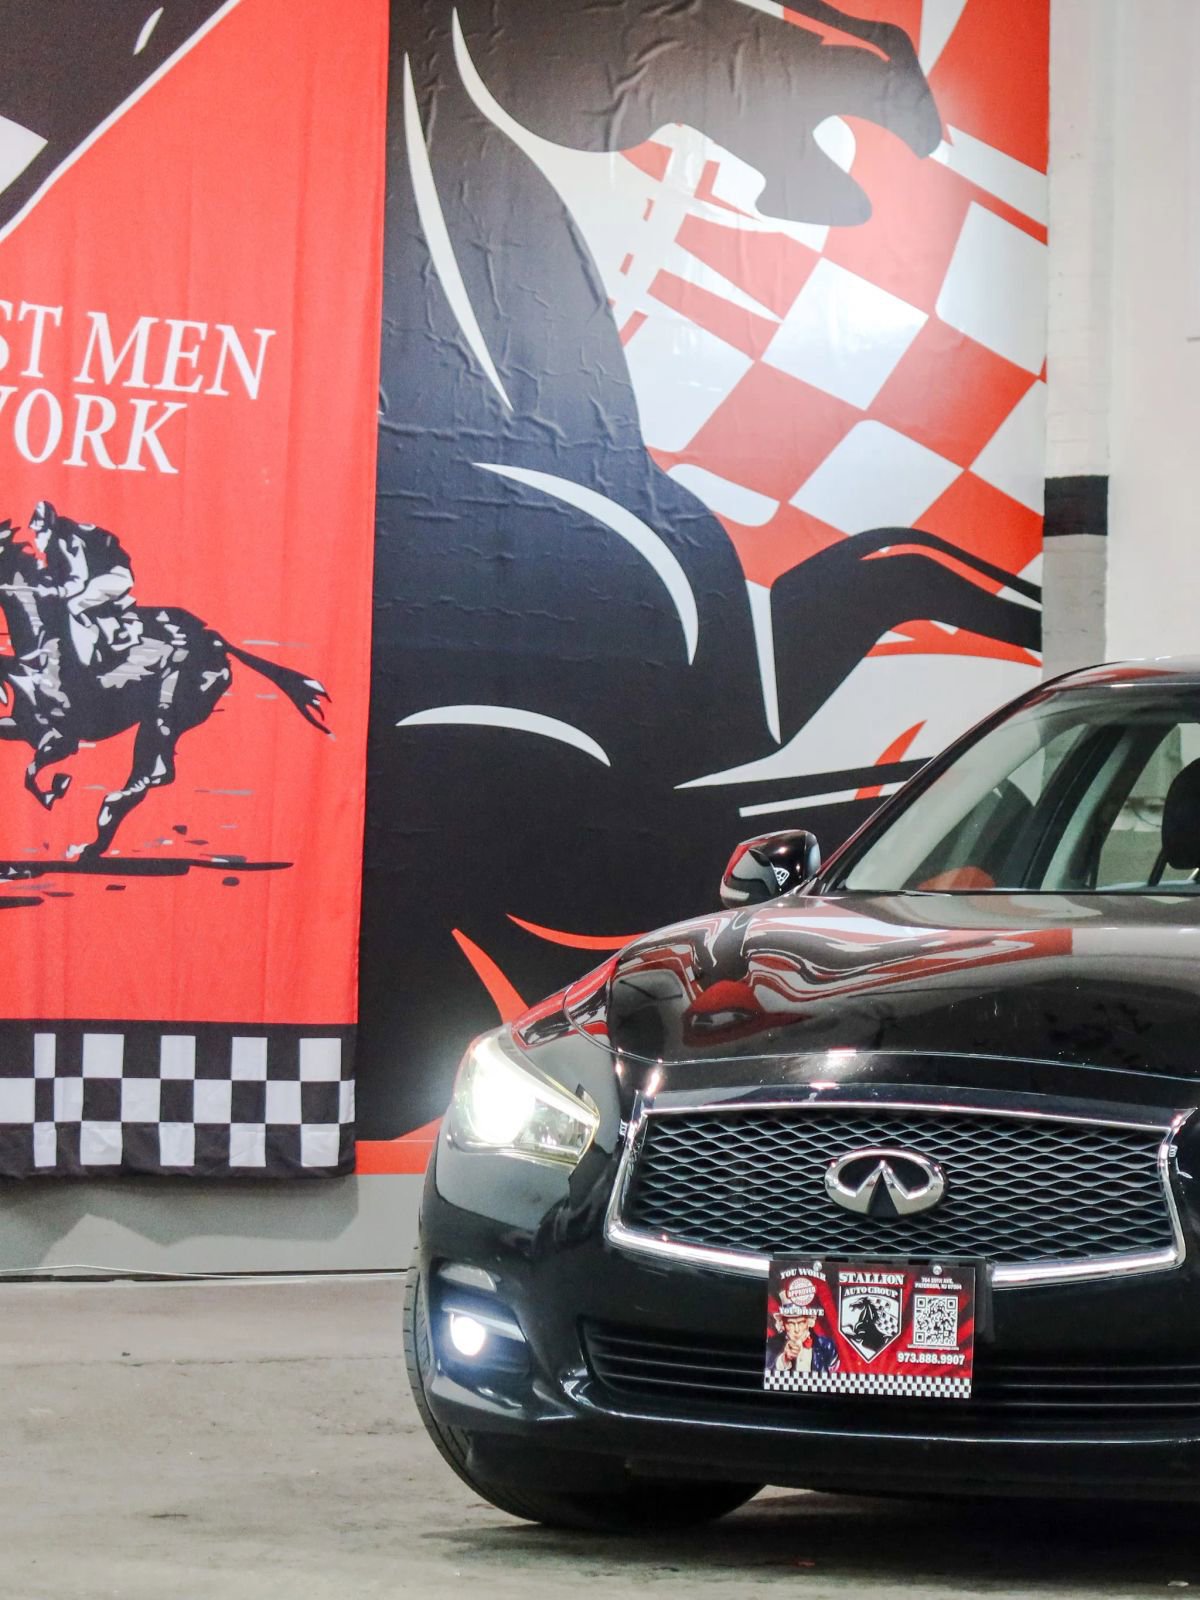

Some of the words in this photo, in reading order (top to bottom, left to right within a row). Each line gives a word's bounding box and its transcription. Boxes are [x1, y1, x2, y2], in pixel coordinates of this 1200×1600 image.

[0, 300, 63, 378] T
[73, 311, 276, 400] MEN
[0, 385, 187, 474] ORK
[780, 1268, 797, 1279] YOU
[798, 1267, 826, 1281] WORK
[839, 1271, 904, 1284] STALLION
[844, 1287, 867, 1296] AUTO
[867, 1287, 898, 1298] GROUP
[797, 1308, 824, 1316] DRIVE
[897, 1352, 965, 1365] 973.888.9907
